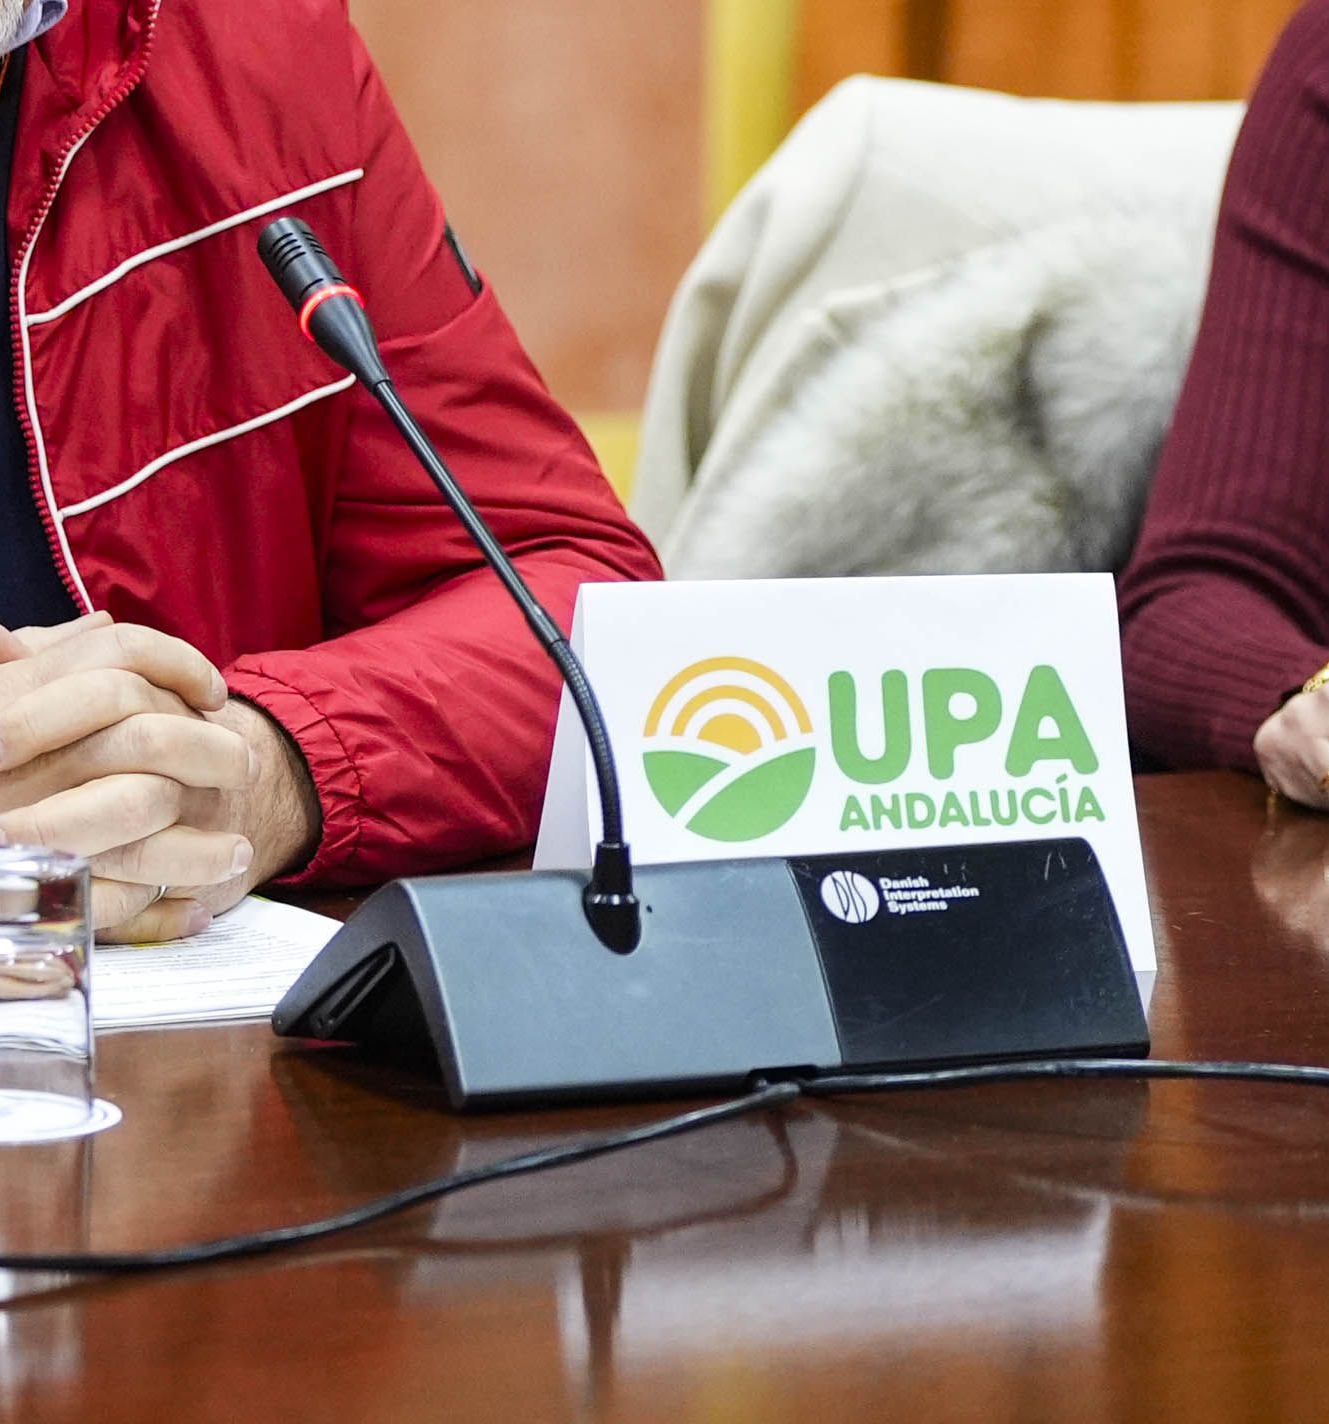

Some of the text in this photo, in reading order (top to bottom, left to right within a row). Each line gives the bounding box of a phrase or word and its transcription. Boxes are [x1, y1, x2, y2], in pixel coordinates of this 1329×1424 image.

[827, 664, 1100, 785] UPA
[839, 773, 1106, 832] ANDALUCÍA
[879, 876, 930, 890] Danish
[883, 886, 980, 902] Interpretation
[887, 901, 949, 915] Systems
